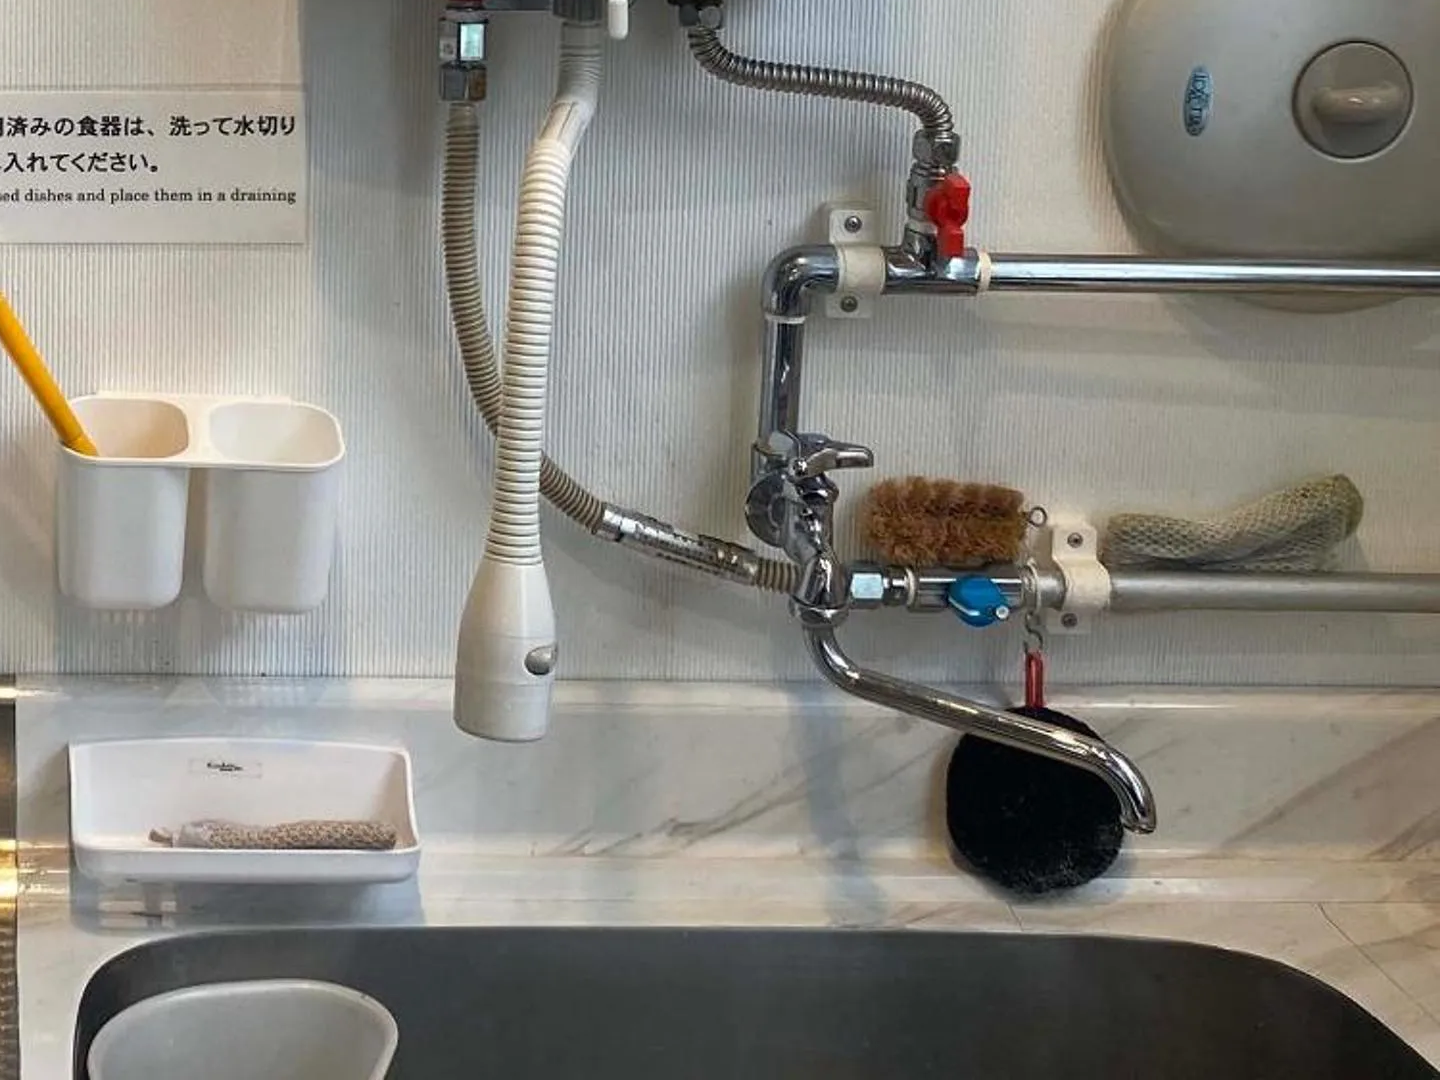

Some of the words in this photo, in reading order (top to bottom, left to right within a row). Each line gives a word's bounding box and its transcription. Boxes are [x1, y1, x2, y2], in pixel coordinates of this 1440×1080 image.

[24, 188, 73, 202] dishes
[76, 188, 105, 202] and
[110, 187, 150, 204] place
[154, 187, 193, 202] them
[197, 187, 212, 201] in
[217, 193, 226, 201] a
[230, 187, 297, 205] draining
